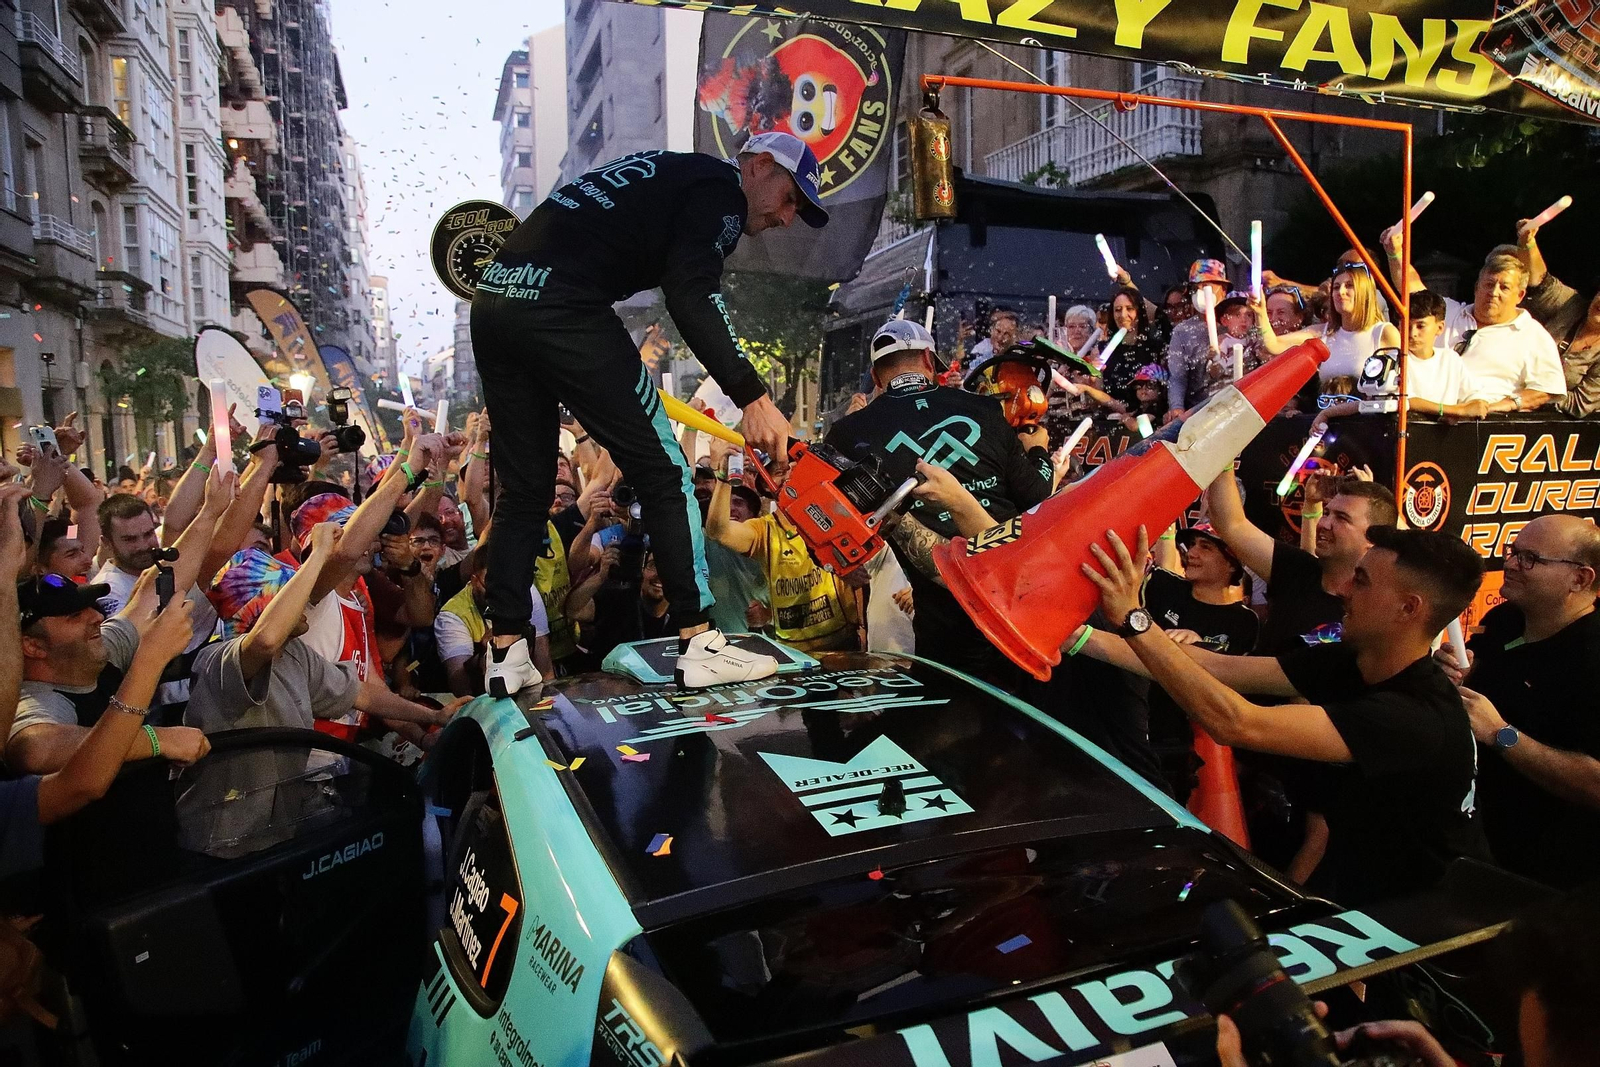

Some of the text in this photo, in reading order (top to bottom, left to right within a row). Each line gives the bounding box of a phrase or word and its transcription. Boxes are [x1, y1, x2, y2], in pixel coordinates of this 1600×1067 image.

[1222, 0, 1494, 97] FANS
[839, 99, 886, 173] FANS
[579, 181, 616, 210] Cagiao
[449, 208, 490, 230] GO!!
[484, 218, 516, 234] GO!!
[504, 284, 540, 301] Team
[1477, 433, 1600, 474] RAL
[1465, 478, 1600, 516] OURE
[807, 506, 829, 531] ECHO
[792, 667, 898, 684] Recambio
[596, 673, 925, 724] RecOficial
[793, 763, 916, 788] REC-DEALER
[302, 831, 385, 881] J.CAGIAO
[459, 846, 490, 913] J.Cagiao
[480, 892, 519, 989] 7
[525, 914, 586, 995] MARINA
[528, 955, 558, 996] RACEWEAR
[895, 909, 1424, 1067] Realvi
[497, 1001, 546, 1067] integralmo
[597, 1024, 626, 1063] RACING
[604, 997, 668, 1067] TRS
